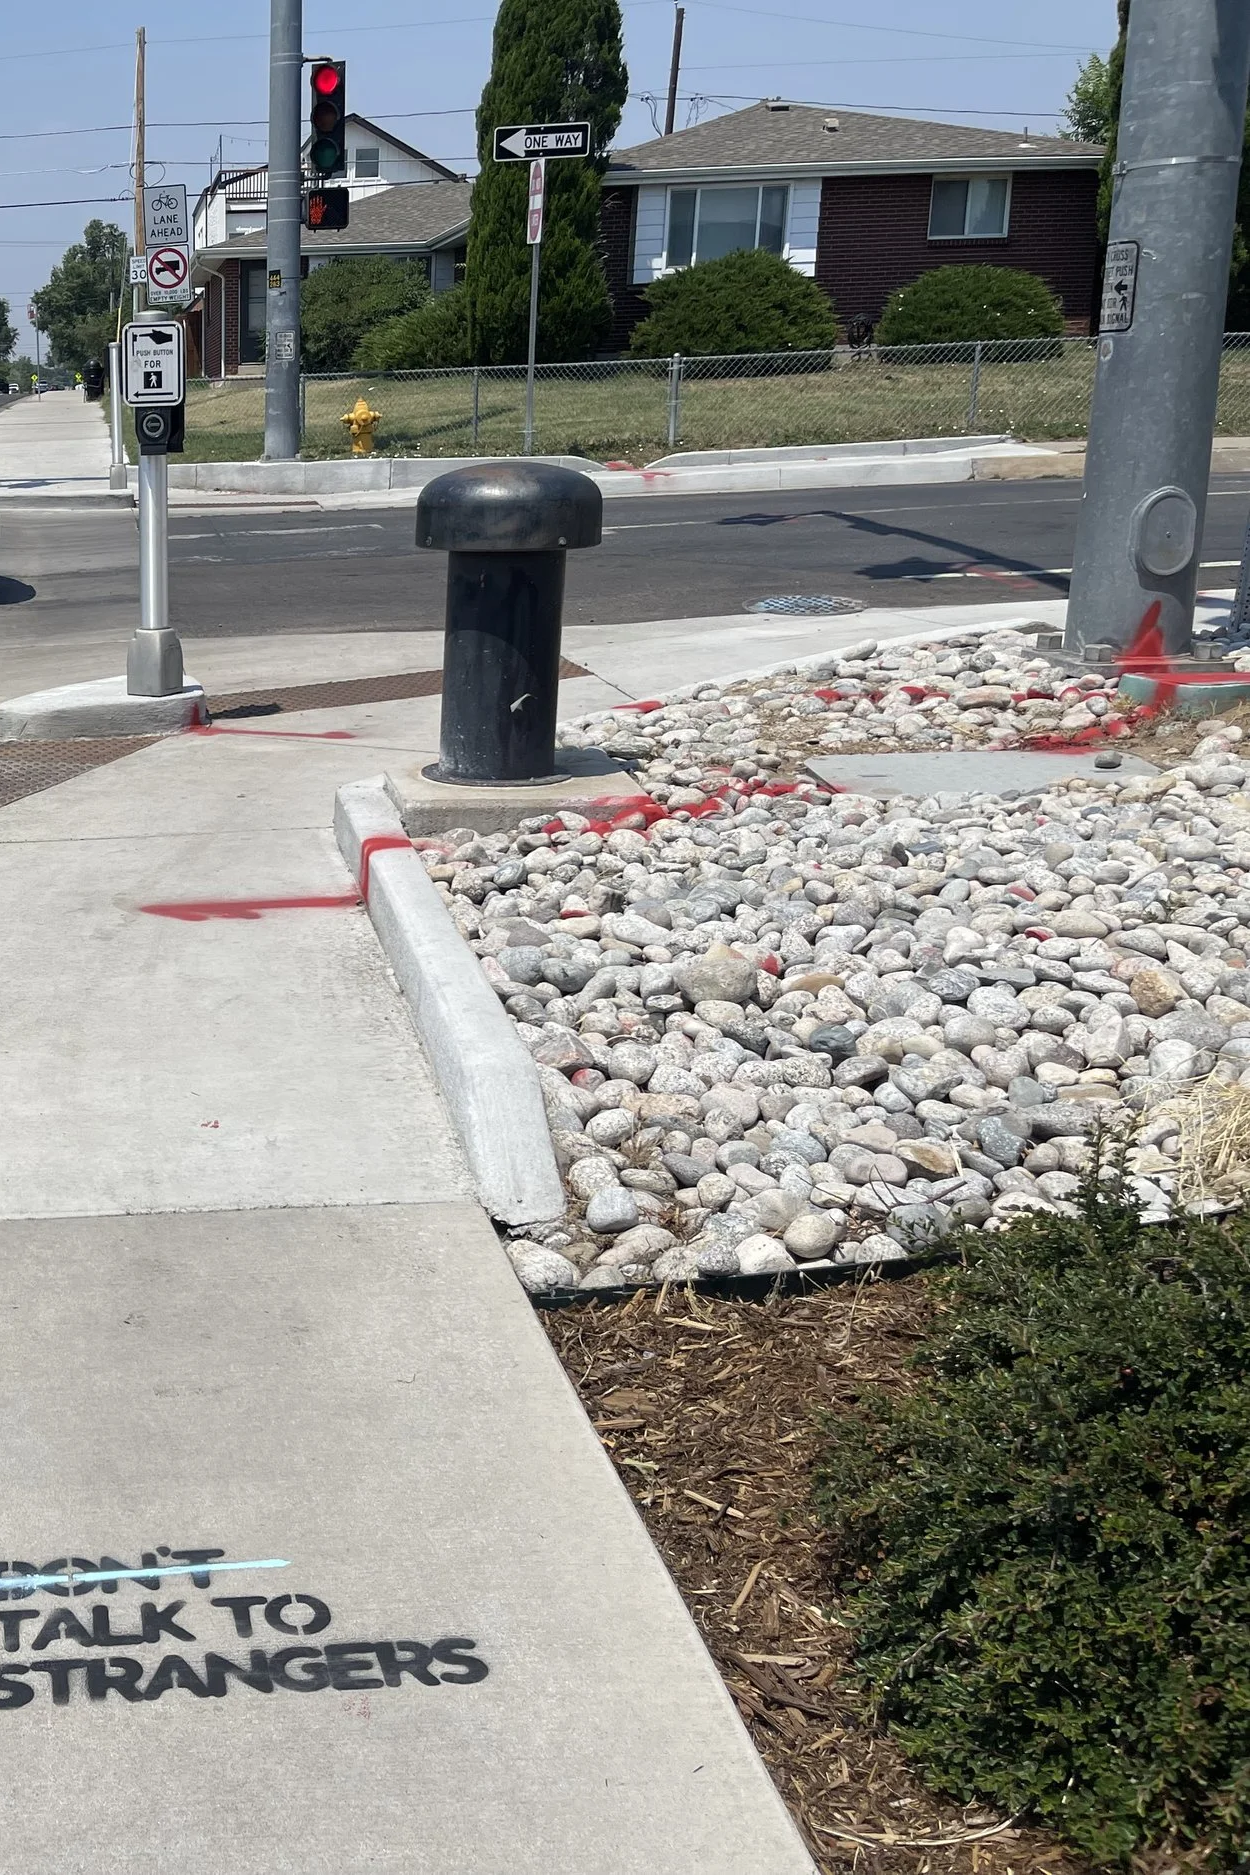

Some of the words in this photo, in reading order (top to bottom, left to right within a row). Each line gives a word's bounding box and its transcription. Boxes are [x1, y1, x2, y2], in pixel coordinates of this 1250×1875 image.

[524, 136, 549, 149] ONE
[554, 134, 581, 147] WAY
[154, 214, 178, 224] LANE
[150, 227, 183, 238] AHEAD
[131, 269, 147, 280] 30
[1115, 265, 1133, 277] PUSH
[144, 360, 161, 368] FOR
[211, 1594, 332, 1638] TO
